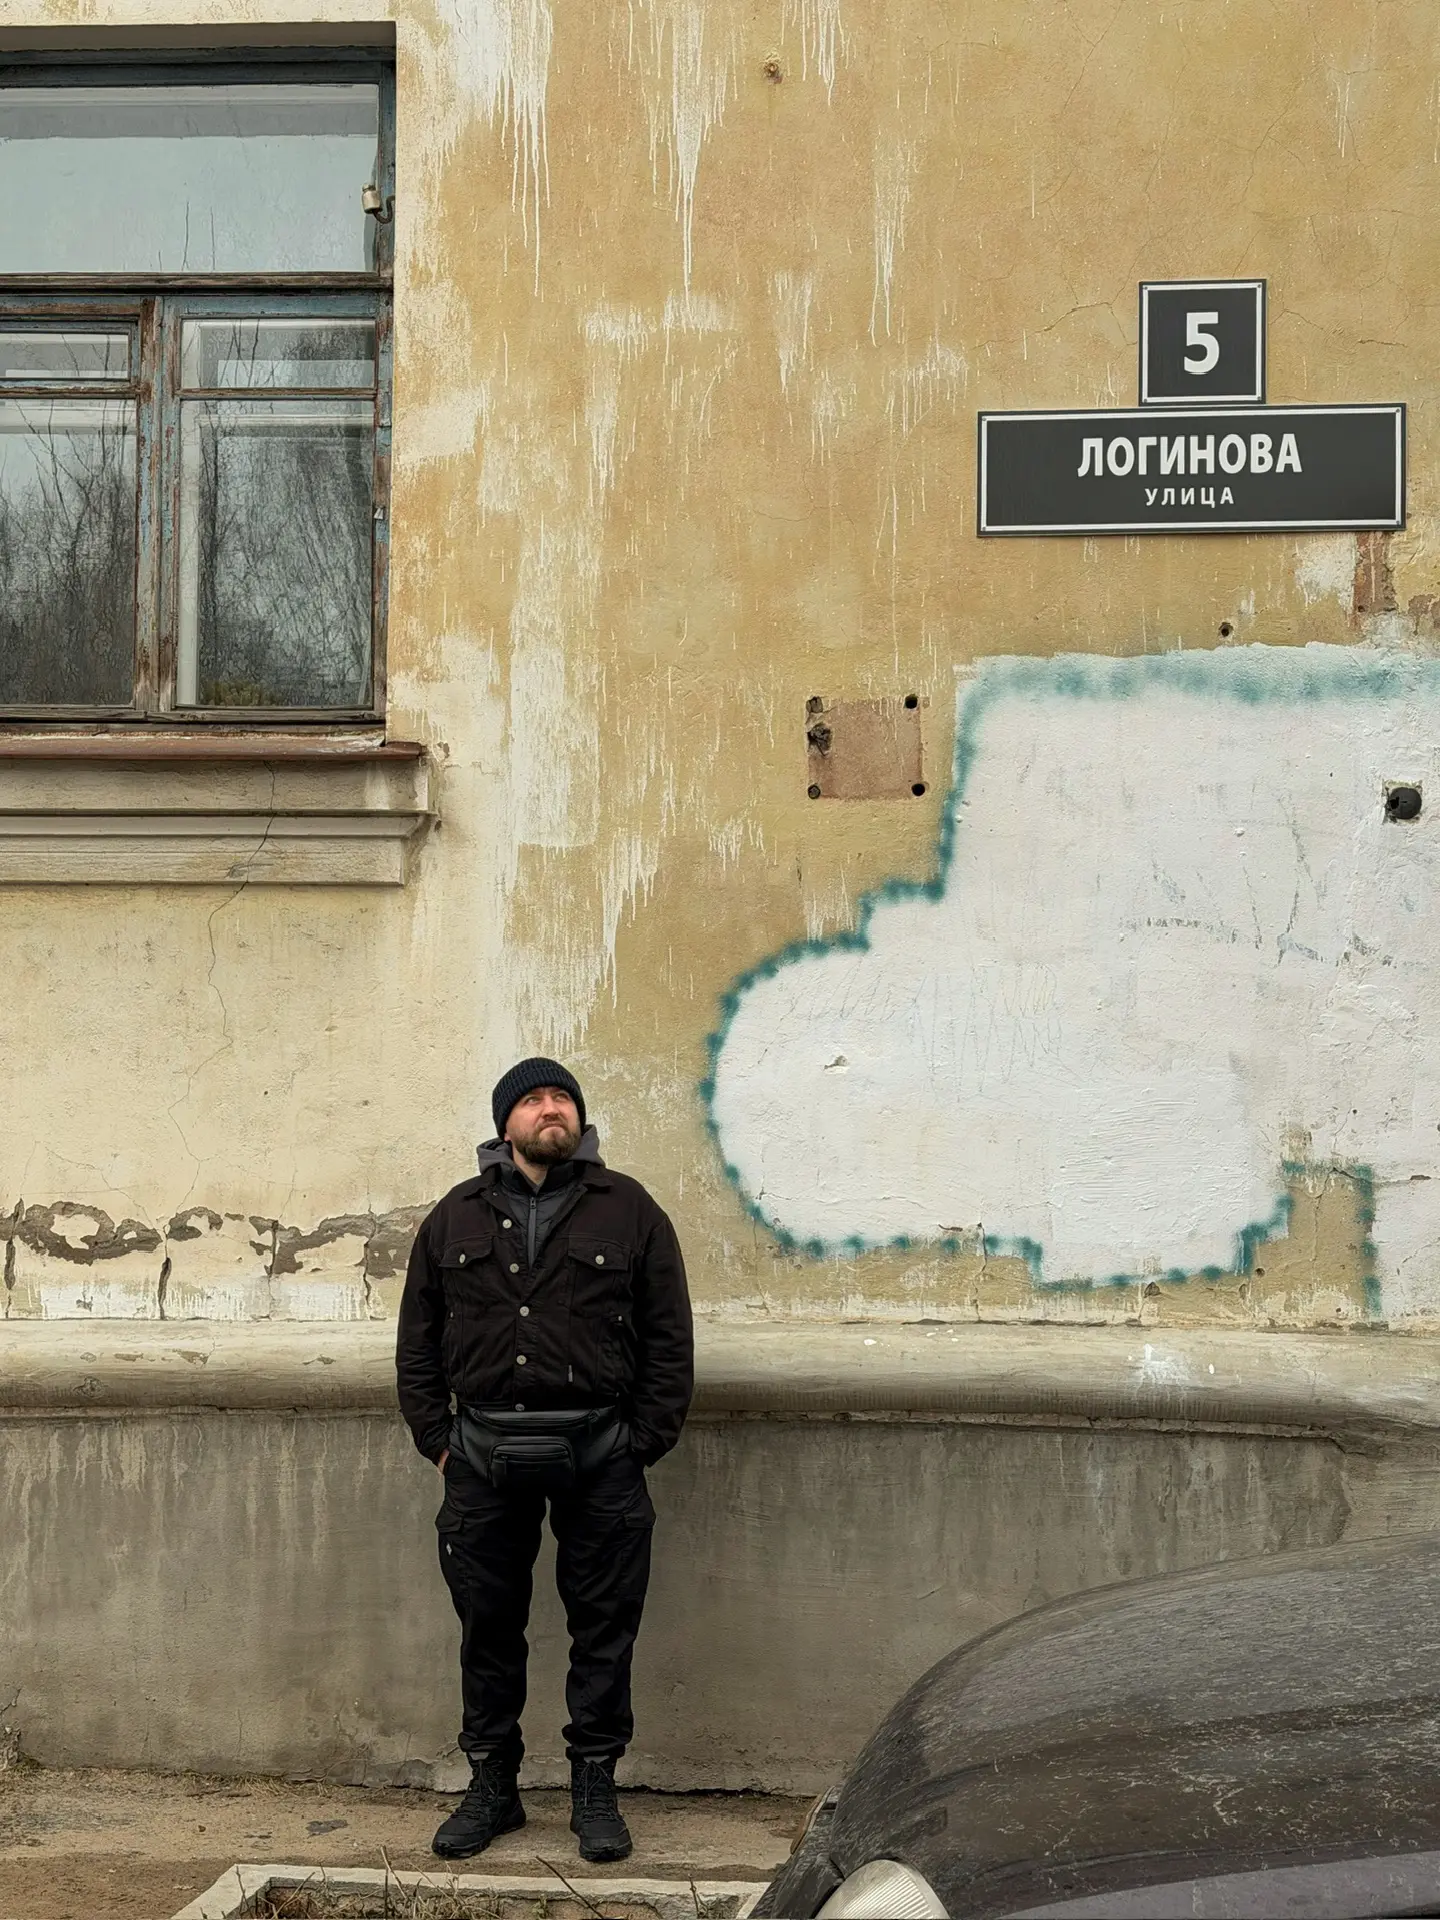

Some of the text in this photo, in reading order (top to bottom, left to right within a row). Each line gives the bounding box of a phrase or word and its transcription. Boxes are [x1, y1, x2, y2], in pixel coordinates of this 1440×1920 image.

[1184, 312, 1220, 374] 5
[1077, 433, 1302, 477] ЛОГИНОВА
[1145, 487, 1234, 508] УЛИЦА
